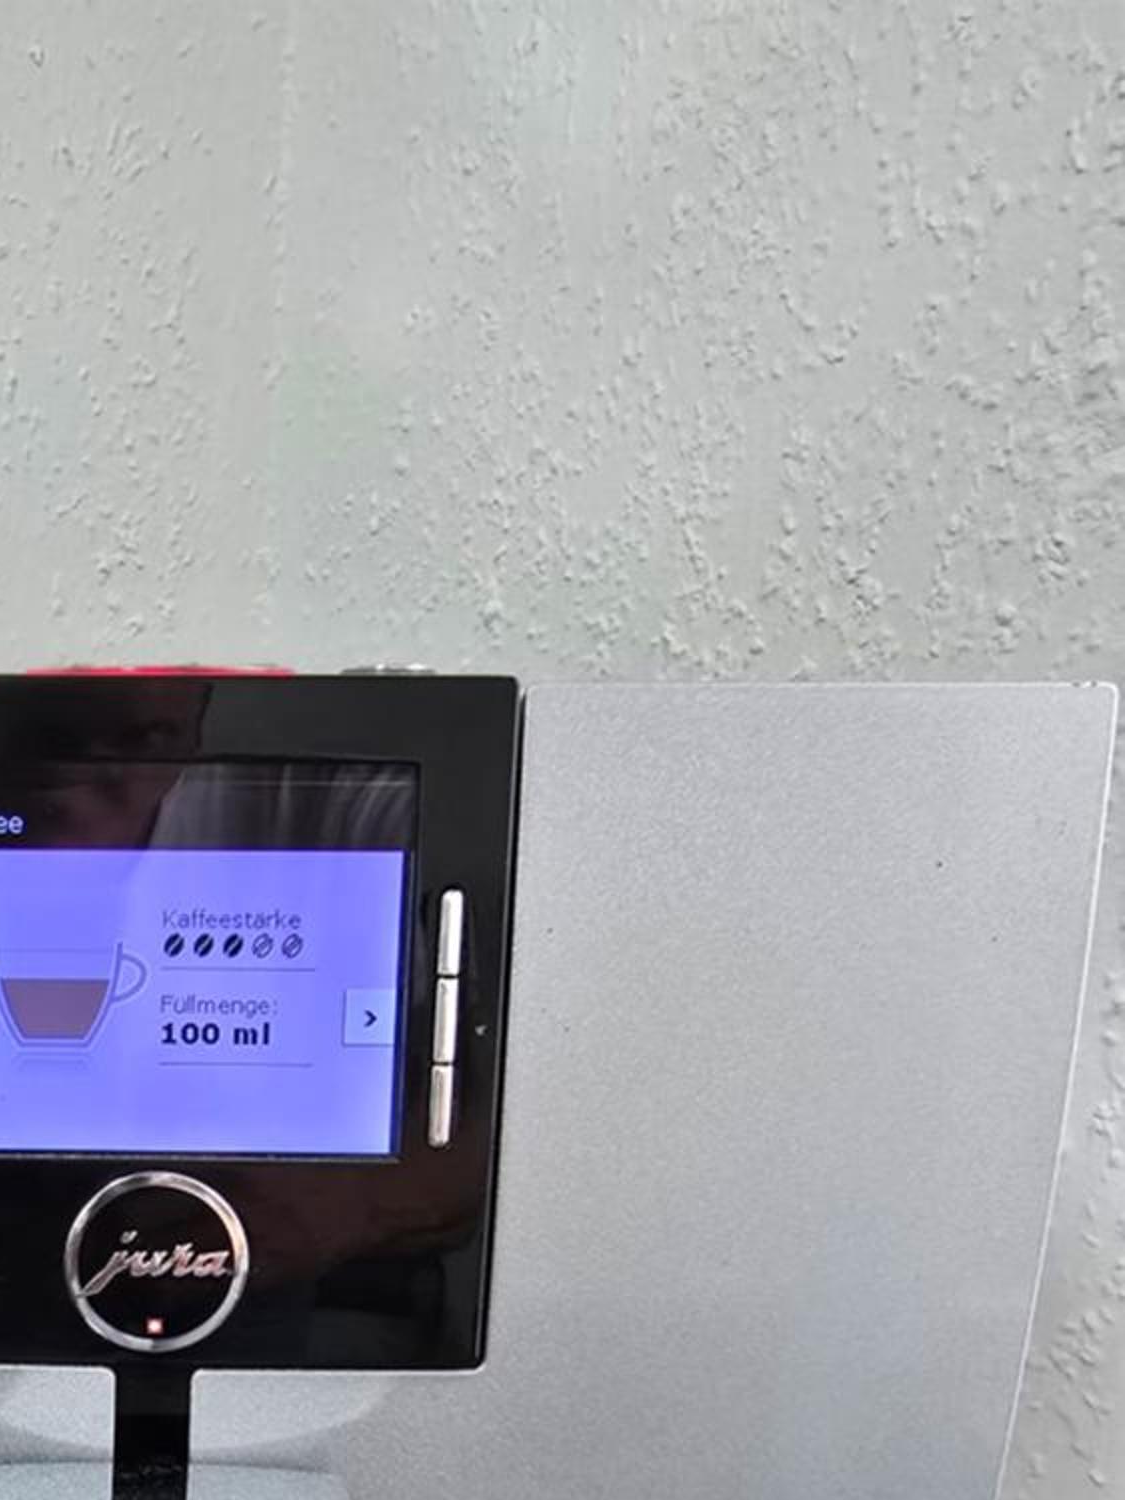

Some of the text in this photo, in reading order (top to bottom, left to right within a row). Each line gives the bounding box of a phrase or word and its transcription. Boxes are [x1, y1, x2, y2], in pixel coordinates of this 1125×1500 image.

[162, 908, 302, 930] Kaffeestärke
[161, 1022, 270, 1046] 100 ml
[76, 1230, 234, 1297] jura
